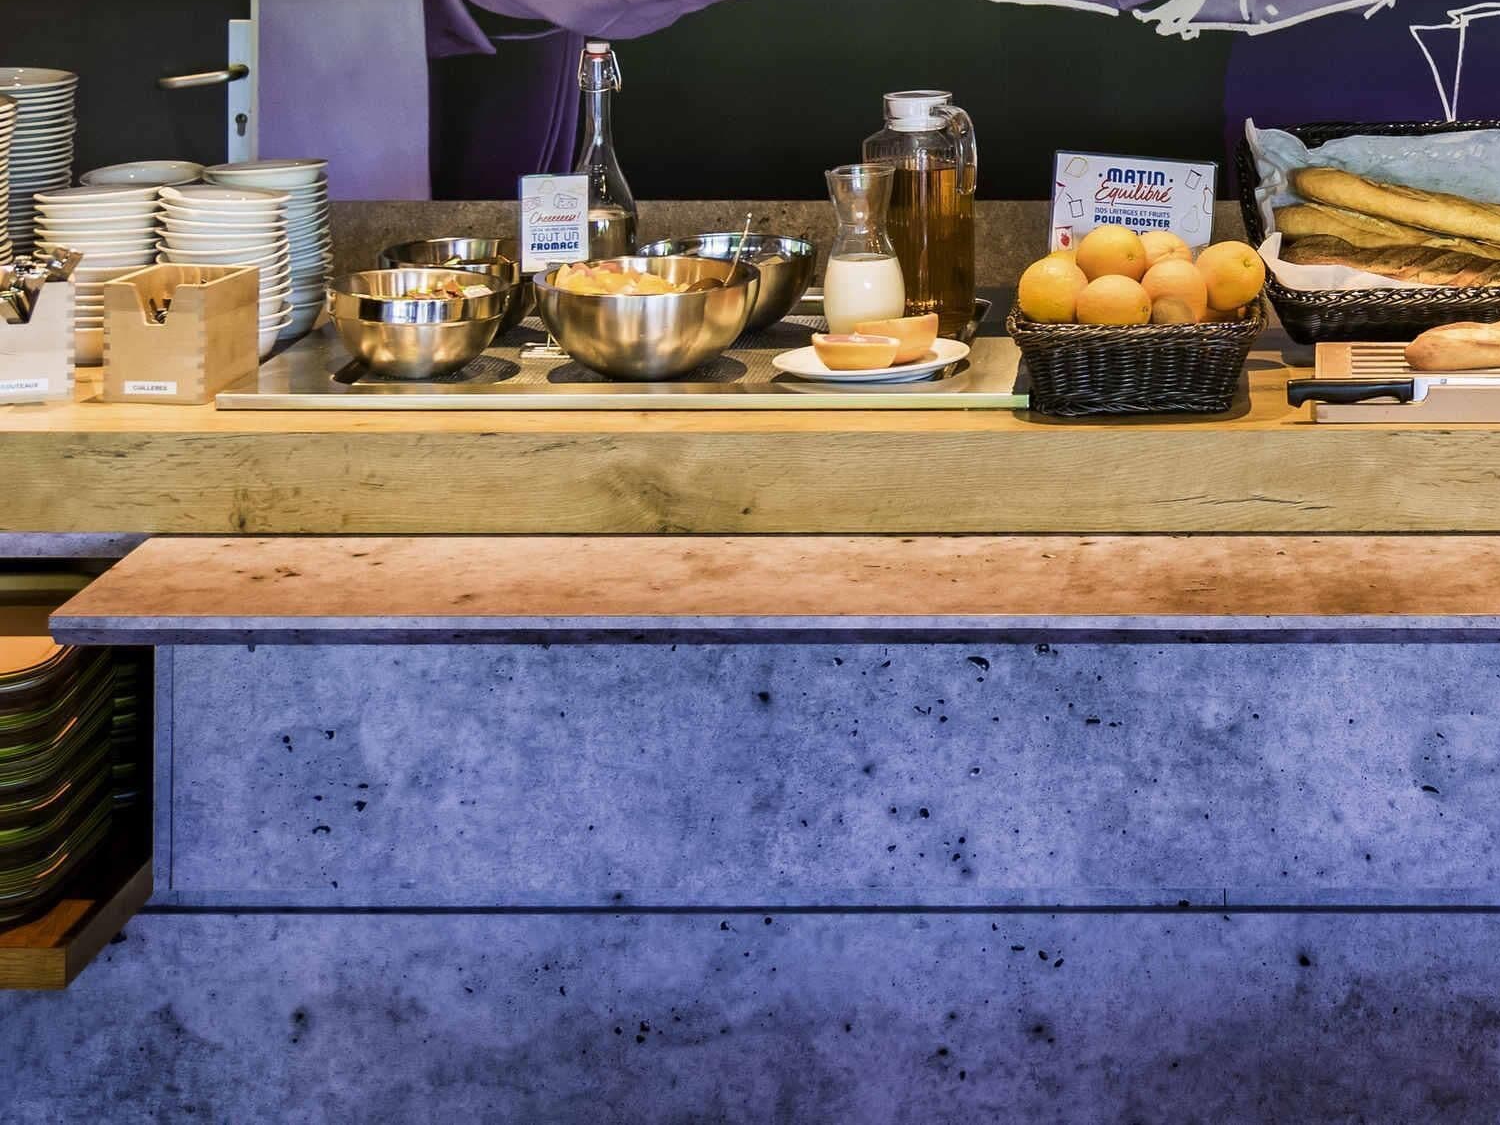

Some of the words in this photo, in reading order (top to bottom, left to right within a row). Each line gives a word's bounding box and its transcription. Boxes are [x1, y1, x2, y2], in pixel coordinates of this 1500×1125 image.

[1106, 168, 1166, 186] MATIN
[1109, 207, 1137, 216] LAITAGES
[1148, 210, 1171, 219] FRUITS
[1094, 214, 1122, 226] POUR
[1125, 216, 1171, 228] BOOSTER
[531, 232, 560, 242] TOUT
[563, 231, 580, 241] UN
[530, 241, 580, 251] FROMAGE
